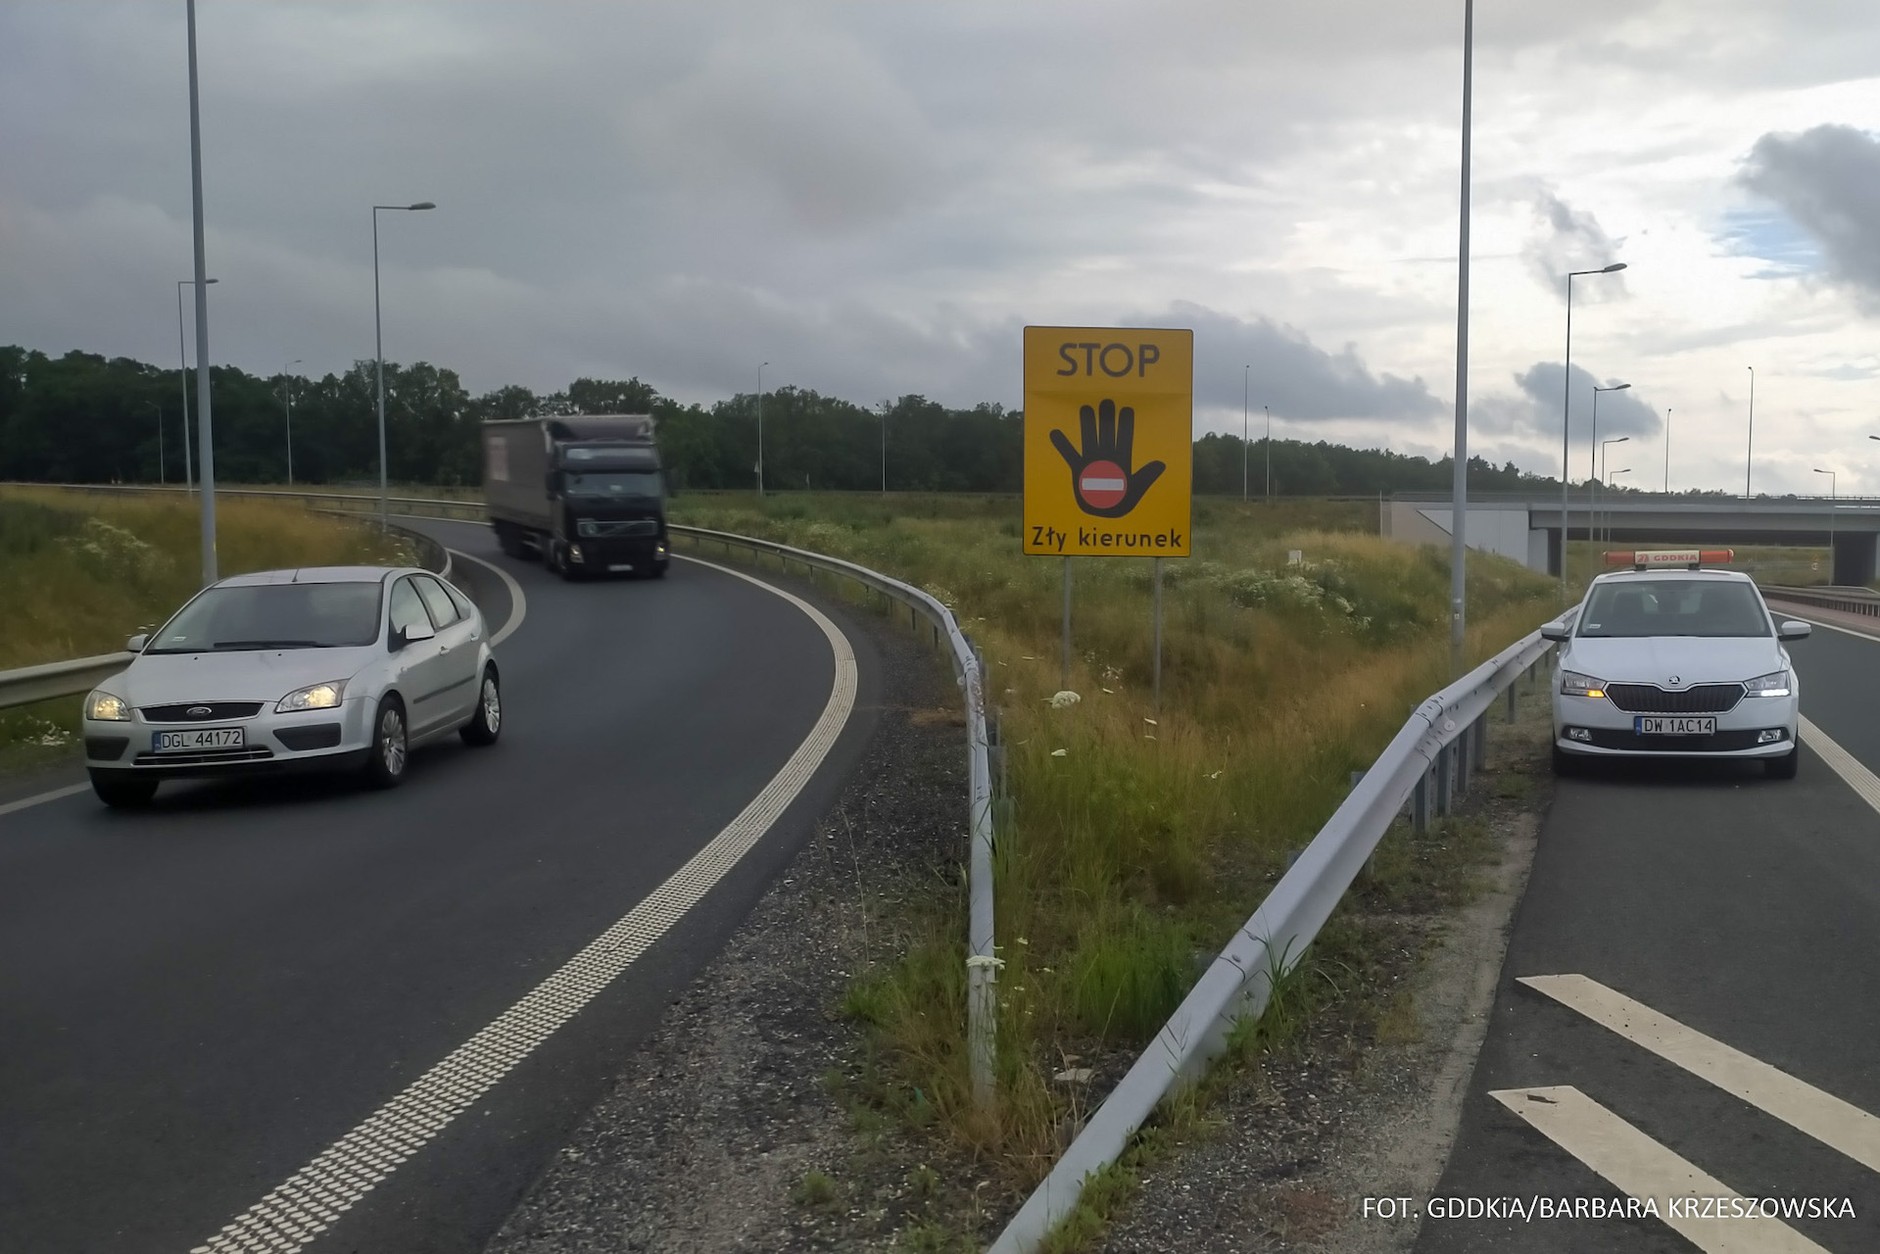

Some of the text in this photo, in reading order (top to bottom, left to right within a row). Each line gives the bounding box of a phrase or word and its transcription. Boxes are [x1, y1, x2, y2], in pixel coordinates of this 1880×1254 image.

[1057, 343, 1160, 377] STOP
[1032, 527, 1182, 552] Zły kierunek
[1644, 719, 1713, 732] DW 1AC14
[162, 730, 241, 748] DGL 44172
